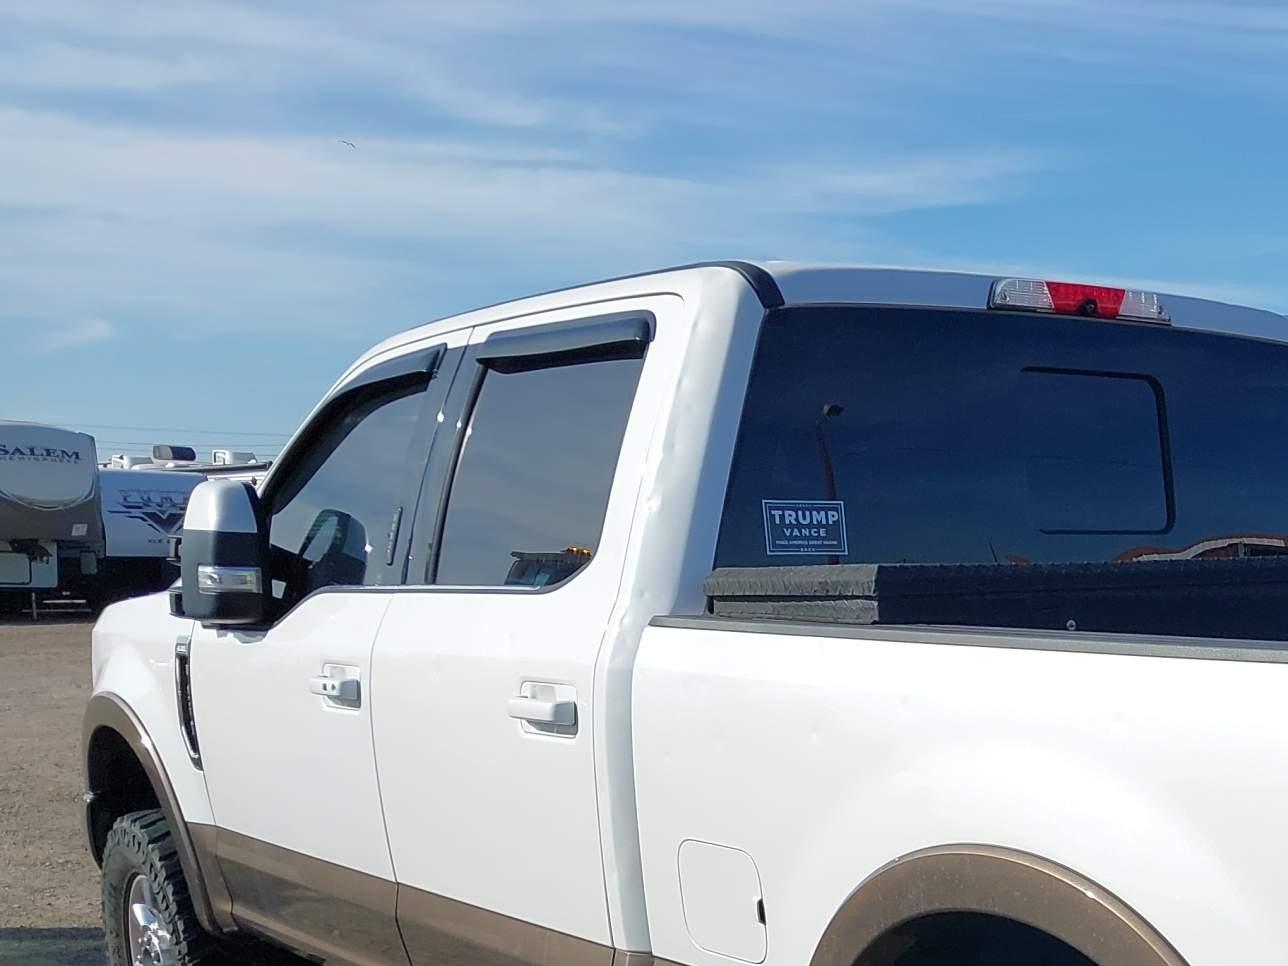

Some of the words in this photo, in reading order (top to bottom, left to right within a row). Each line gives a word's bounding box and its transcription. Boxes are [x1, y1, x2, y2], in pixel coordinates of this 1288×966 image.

[0, 444, 81, 460] SALEM
[771, 510, 839, 525] TRUMP
[783, 528, 827, 537] VANCE
